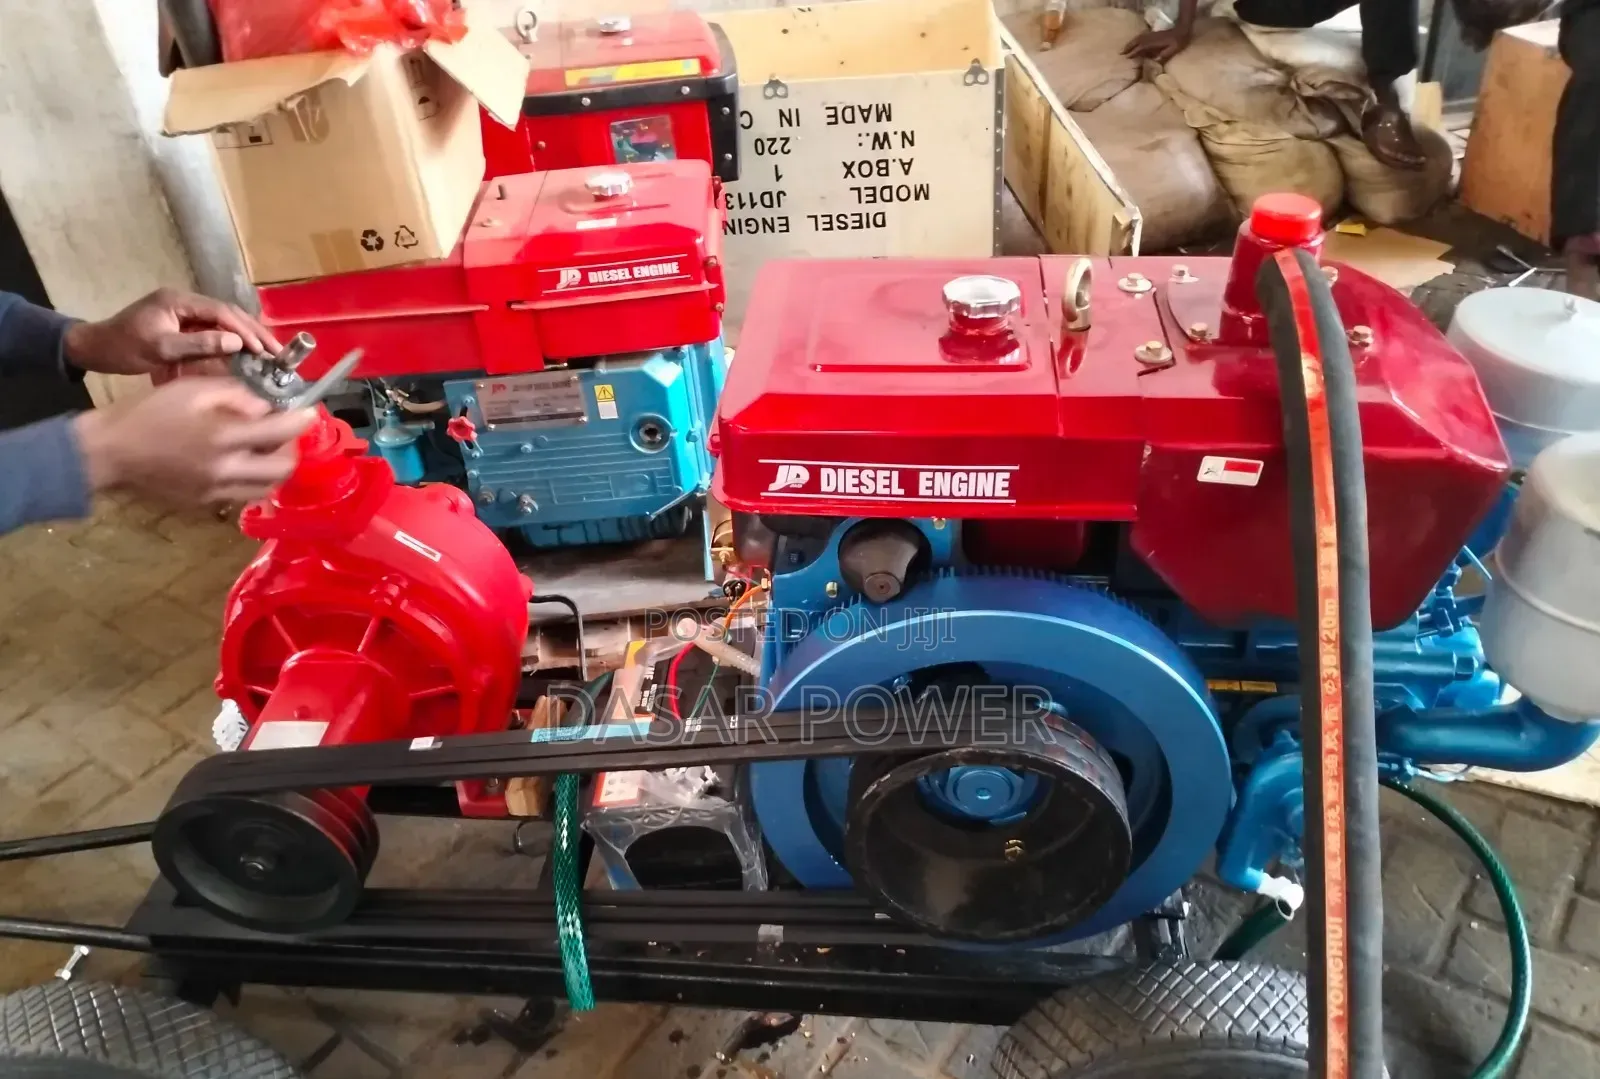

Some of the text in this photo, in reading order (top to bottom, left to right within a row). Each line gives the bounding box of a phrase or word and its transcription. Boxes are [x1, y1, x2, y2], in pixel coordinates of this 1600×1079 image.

[739, 104, 892, 130] MADE IN C
[754, 131, 915, 156] N.W.: 220
[774, 158, 914, 183] A.BOX 1
[850, 184, 930, 204] MODEL
[807, 212, 887, 232] DIESEL
[588, 267, 632, 284] DIESEL
[633, 261, 680, 279] ENGINE
[820, 468, 905, 496] DIESEL
[918, 471, 1010, 498] ENGINE
[1328, 916, 1345, 1018] YONGHUI
